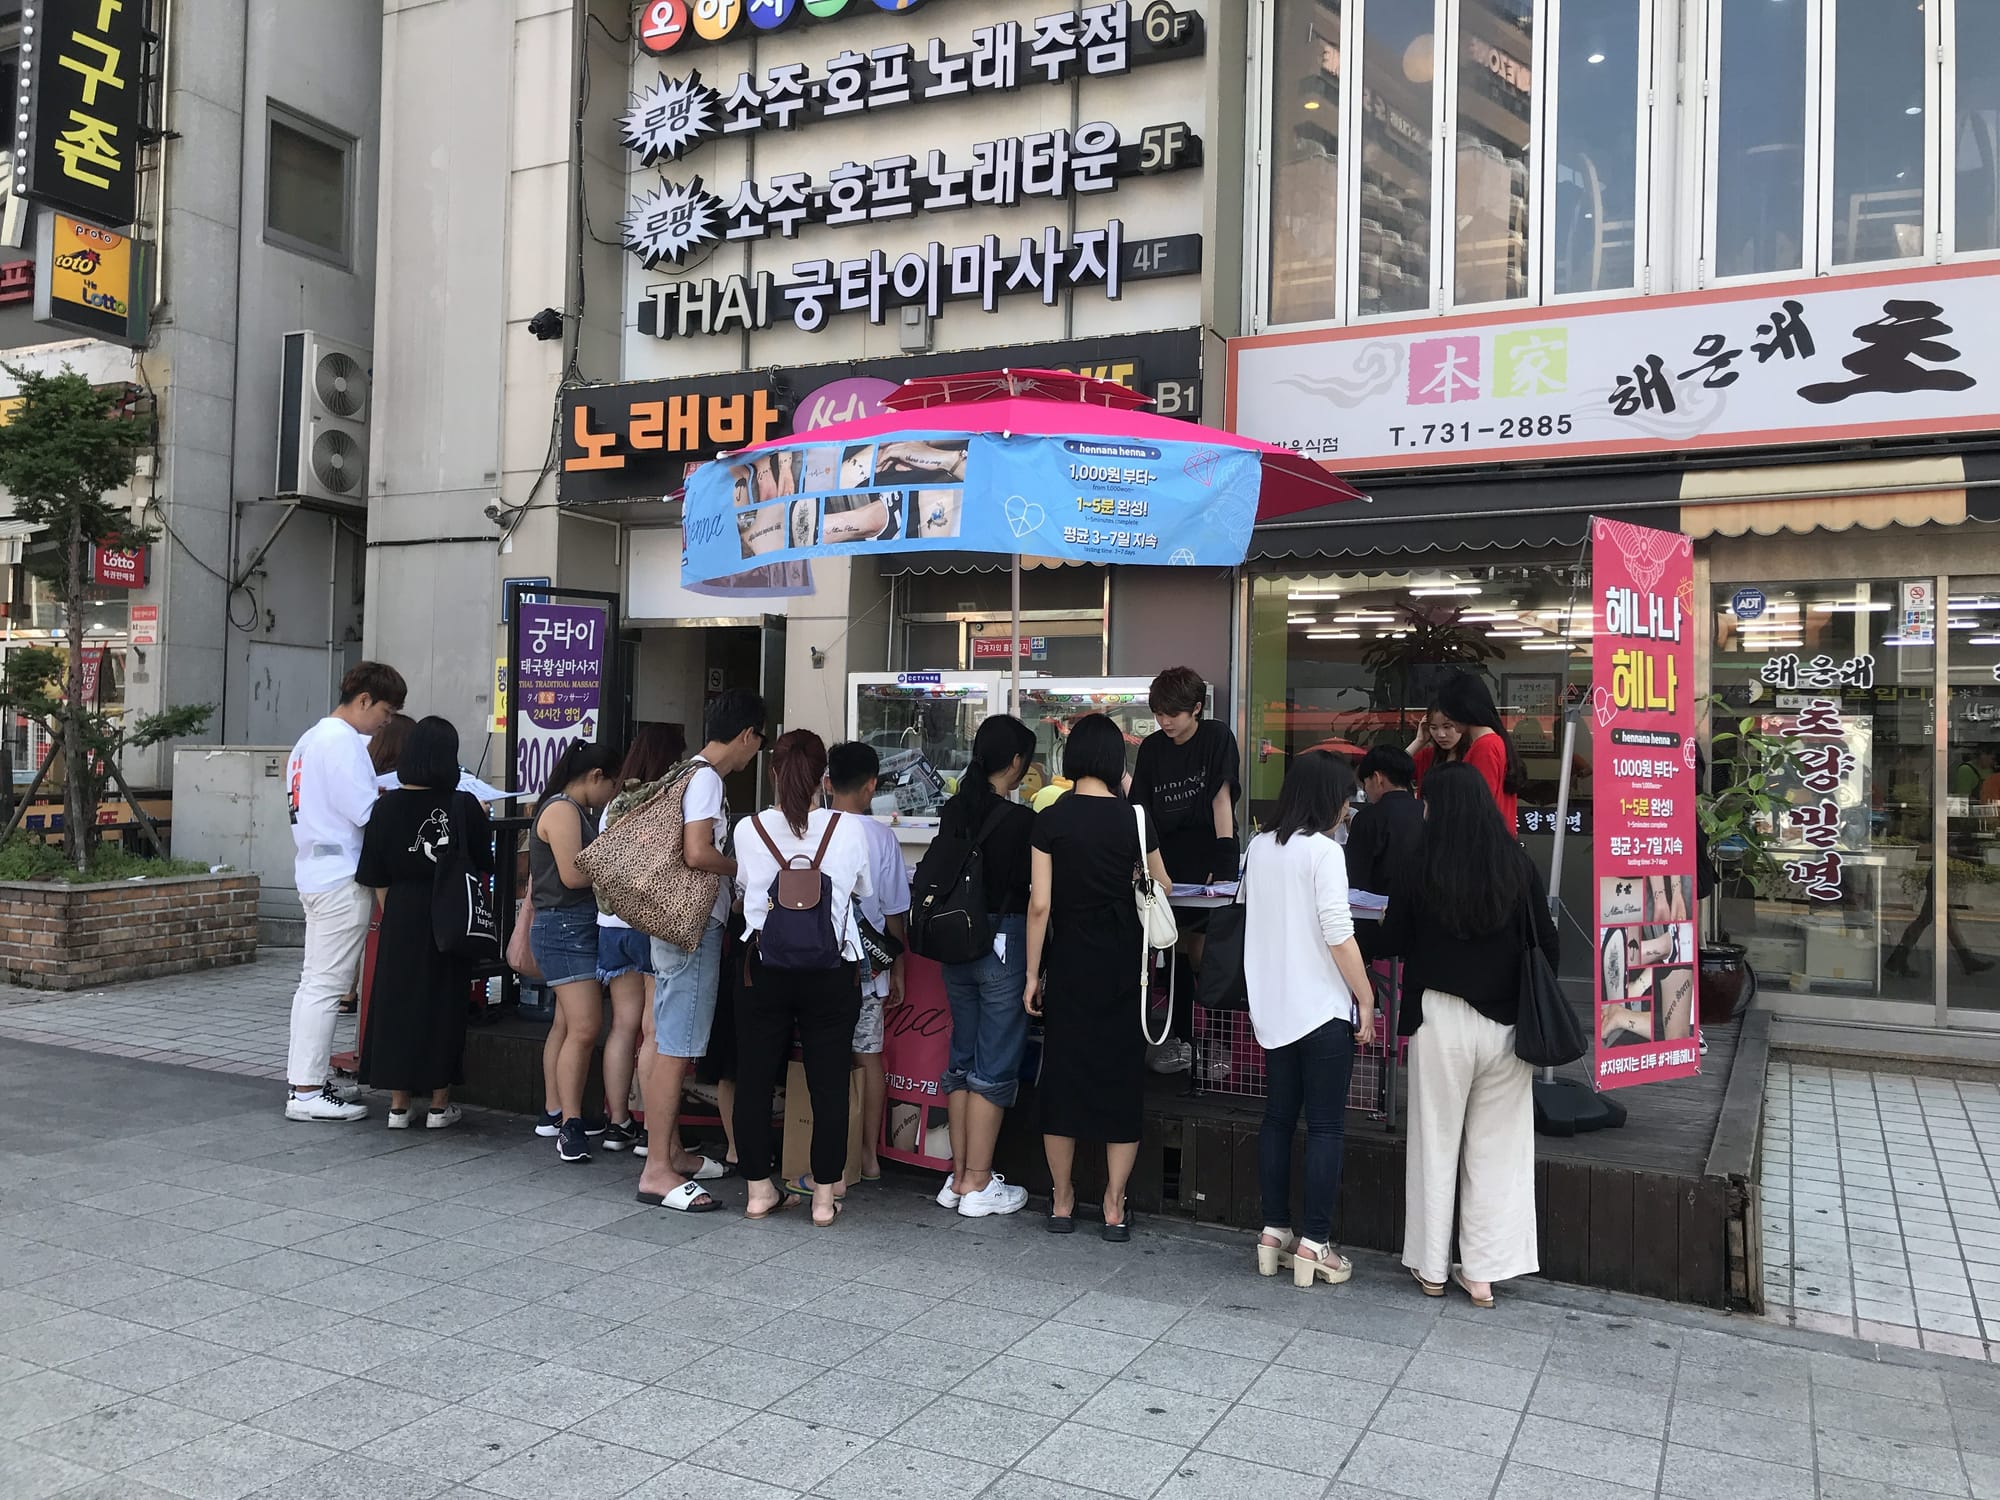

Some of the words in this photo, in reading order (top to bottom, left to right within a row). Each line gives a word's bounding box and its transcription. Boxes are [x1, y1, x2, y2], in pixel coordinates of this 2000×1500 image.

[642, 95, 693, 140] 루팡
[925, 20, 1017, 98] 노래
[1031, 0, 1129, 81] 주점
[1143, 5, 1188, 43] 6F
[644, 203, 696, 245] 루팡
[925, 121, 1118, 209] 노래타운
[1140, 124, 1185, 169] 5F
[75, 225, 112, 244] proto
[55, 254, 96, 273] toto
[646, 271, 773, 338] THAI
[785, 219, 1120, 333] 궁타이마사지
[1132, 241, 1168, 272] 4F
[82, 287, 127, 314] Lotto
[1608, 299, 1816, 416] 해운대
[1418, 335, 1567, 403] 本家
[1156, 381, 1195, 414] B1
[1080, 443, 1118, 456] hennana
[1119, 446, 1146, 458] henna
[1069, 464, 1121, 484] 1,000원
[1123, 468, 1158, 485] 부터~
[1076, 496, 1115, 515] 1~5분
[1117, 500, 1148, 517] 완성!
[1063, 526, 1090, 545] 평균
[1132, 532, 1158, 549] 지속
[103, 554, 135, 570] Lotto
[103, 569, 135, 582] 복권판매점
[1605, 586, 1682, 642] 헤나나
[1737, 598, 1761, 610] ADT
[528, 618, 595, 654] 궁타이
[977, 643, 1002, 653] 관계자외
[520, 658, 599, 677] 태국황실마사지
[1761, 653, 1875, 689] 해운대
[1612, 648, 1678, 712] 헤나
[533, 707, 561, 722] 24시간
[564, 707, 581, 722] 영업
[1622, 731, 1650, 744] hennana
[1650, 734, 1671, 745] henna
[1612, 758, 1652, 778] 1,000원
[1653, 760, 1679, 779] 부터~
[1620, 798, 1649, 816] 1~5분
[1650, 799, 1673, 817] 완성!
[1780, 699, 1856, 900] 초량밀면
[1610, 836, 1632, 856] 평균
[1664, 837, 1683, 856] 지속
[1600, 1054, 1640, 1077] #지워지는
[1641, 1052, 1658, 1071] 타투
[1658, 1047, 1696, 1069] #커플헤나
